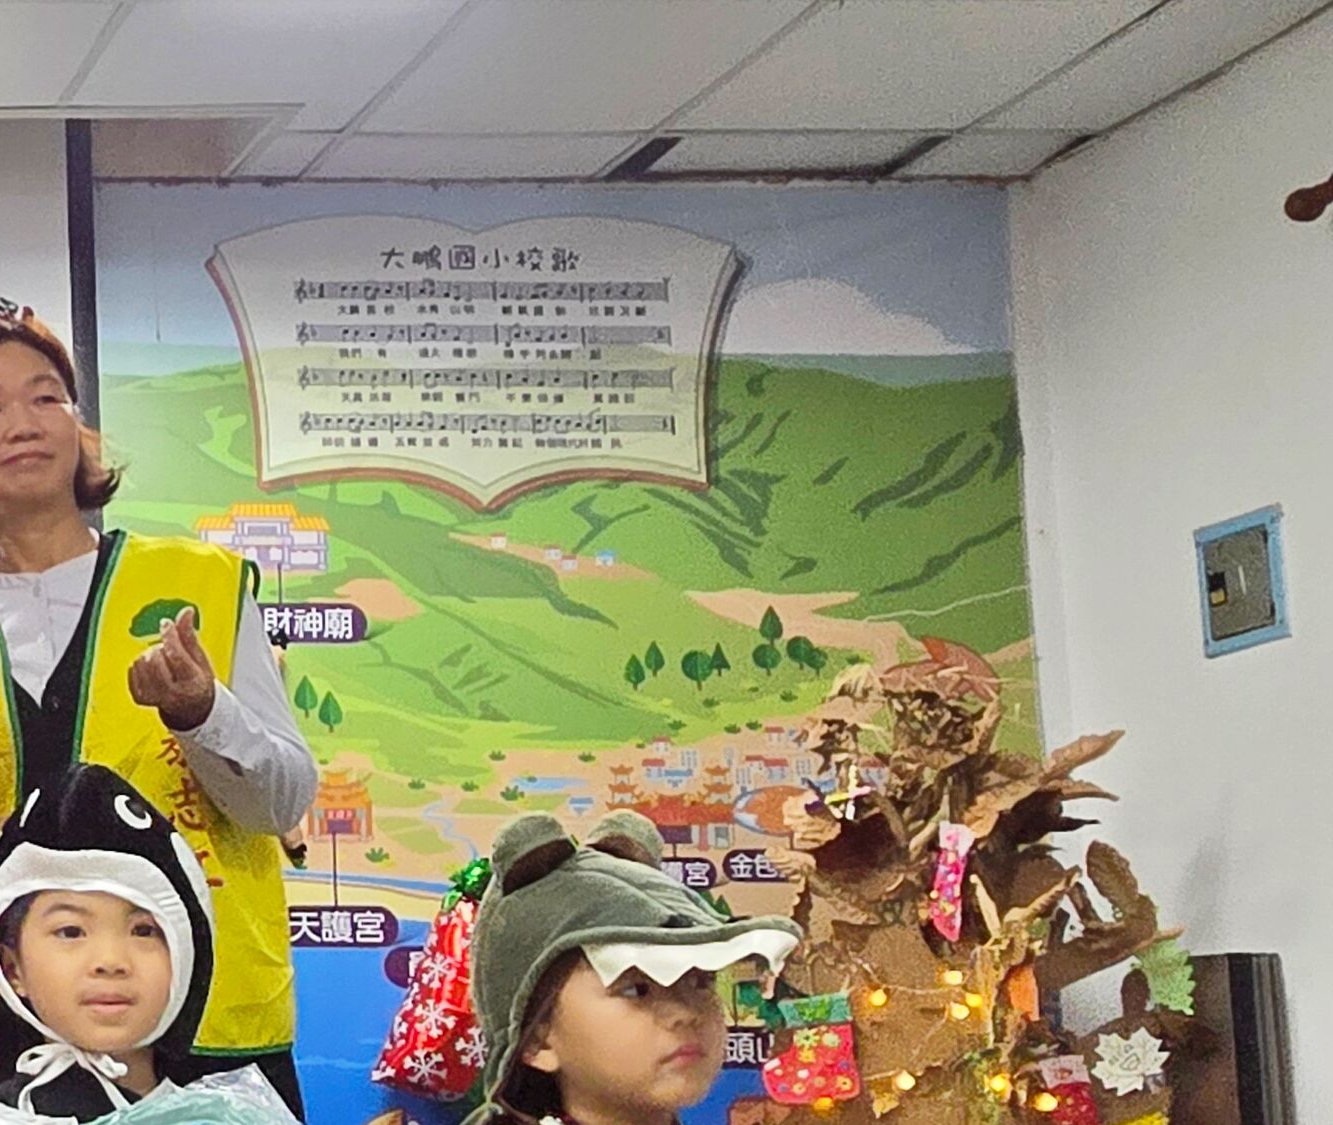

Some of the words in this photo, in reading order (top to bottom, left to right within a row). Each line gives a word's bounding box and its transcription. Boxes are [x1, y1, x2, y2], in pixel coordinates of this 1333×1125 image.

[380, 245, 580, 272] 大鵬國小校歌
[263, 607, 354, 640] 財神廟
[288, 910, 386, 944] 天護宮
